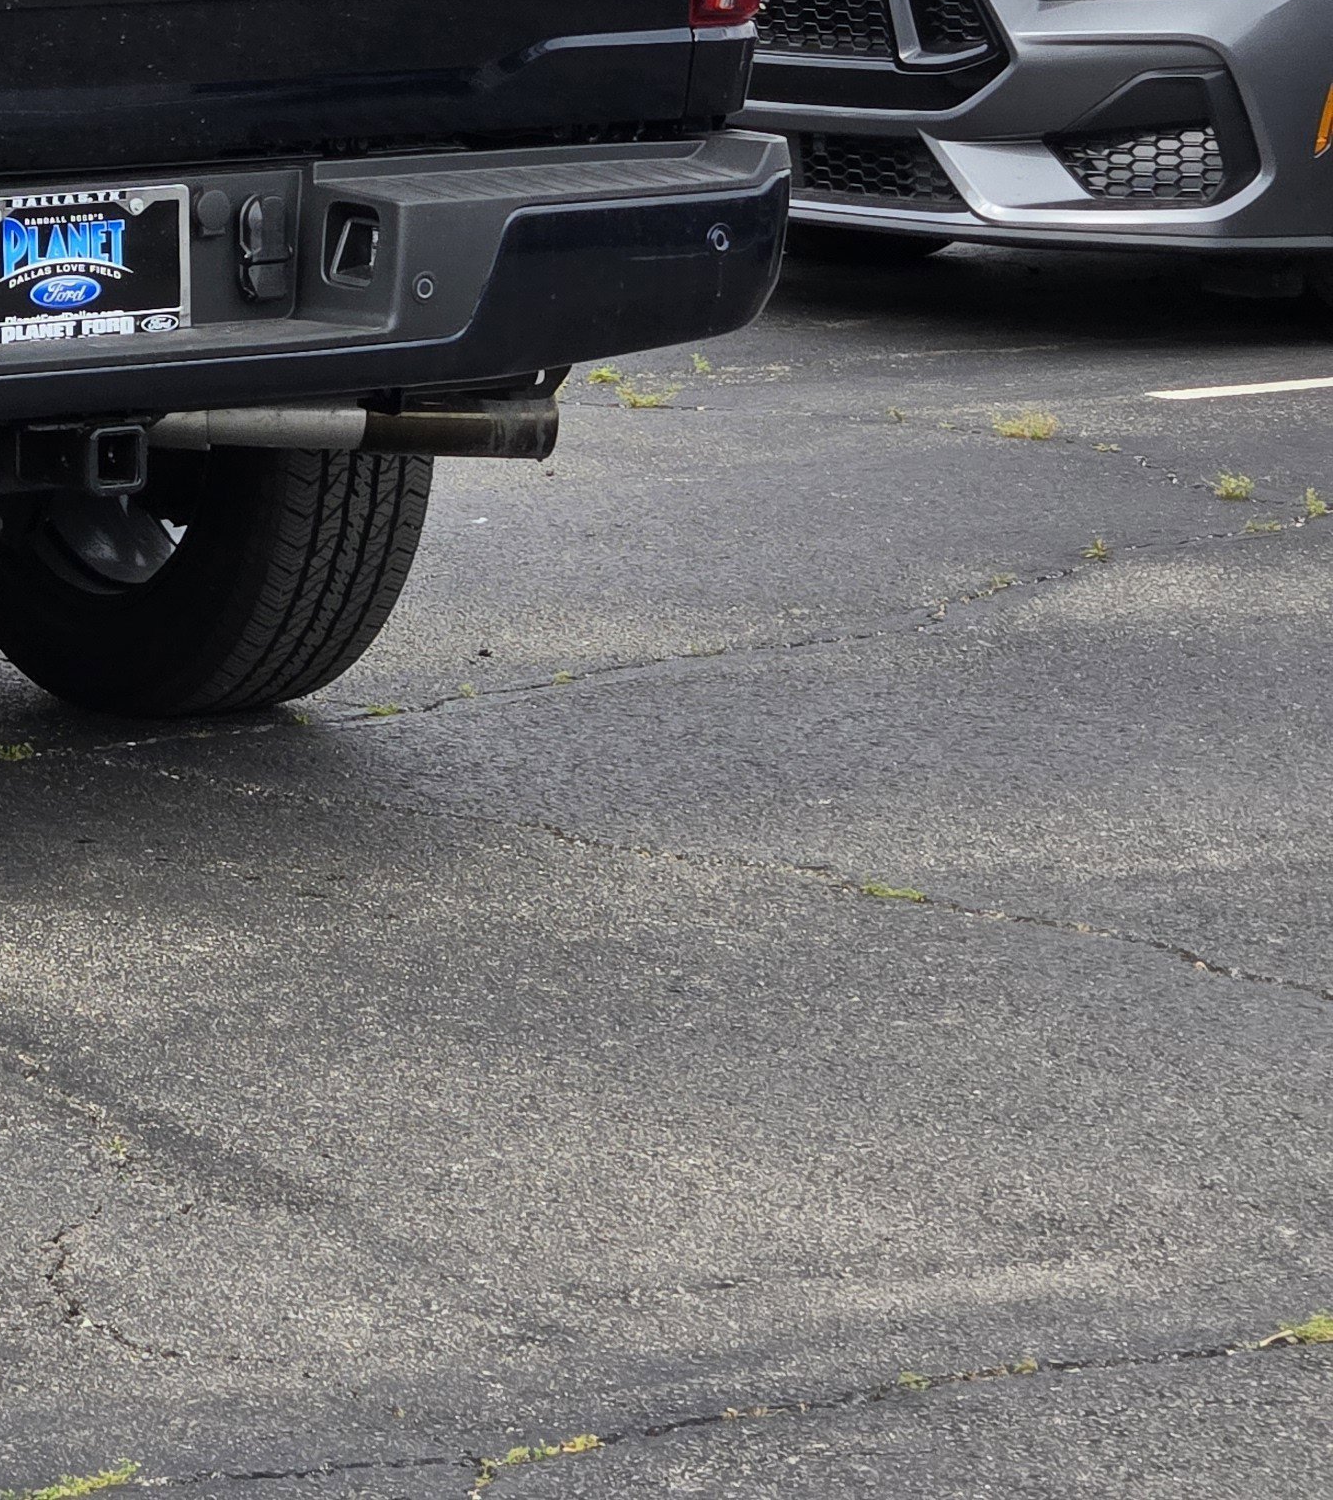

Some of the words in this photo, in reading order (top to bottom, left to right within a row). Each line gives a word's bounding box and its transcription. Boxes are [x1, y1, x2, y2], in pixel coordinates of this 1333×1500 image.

[2, 216, 126, 279] PLANET
[8, 266, 52, 289] DALLAS
[56, 263, 86, 273] LOVE
[89, 264, 123, 280] FIELD
[42, 279, 88, 304] Ford
[0, 319, 78, 345] PLANET
[81, 315, 135, 336] FORD
